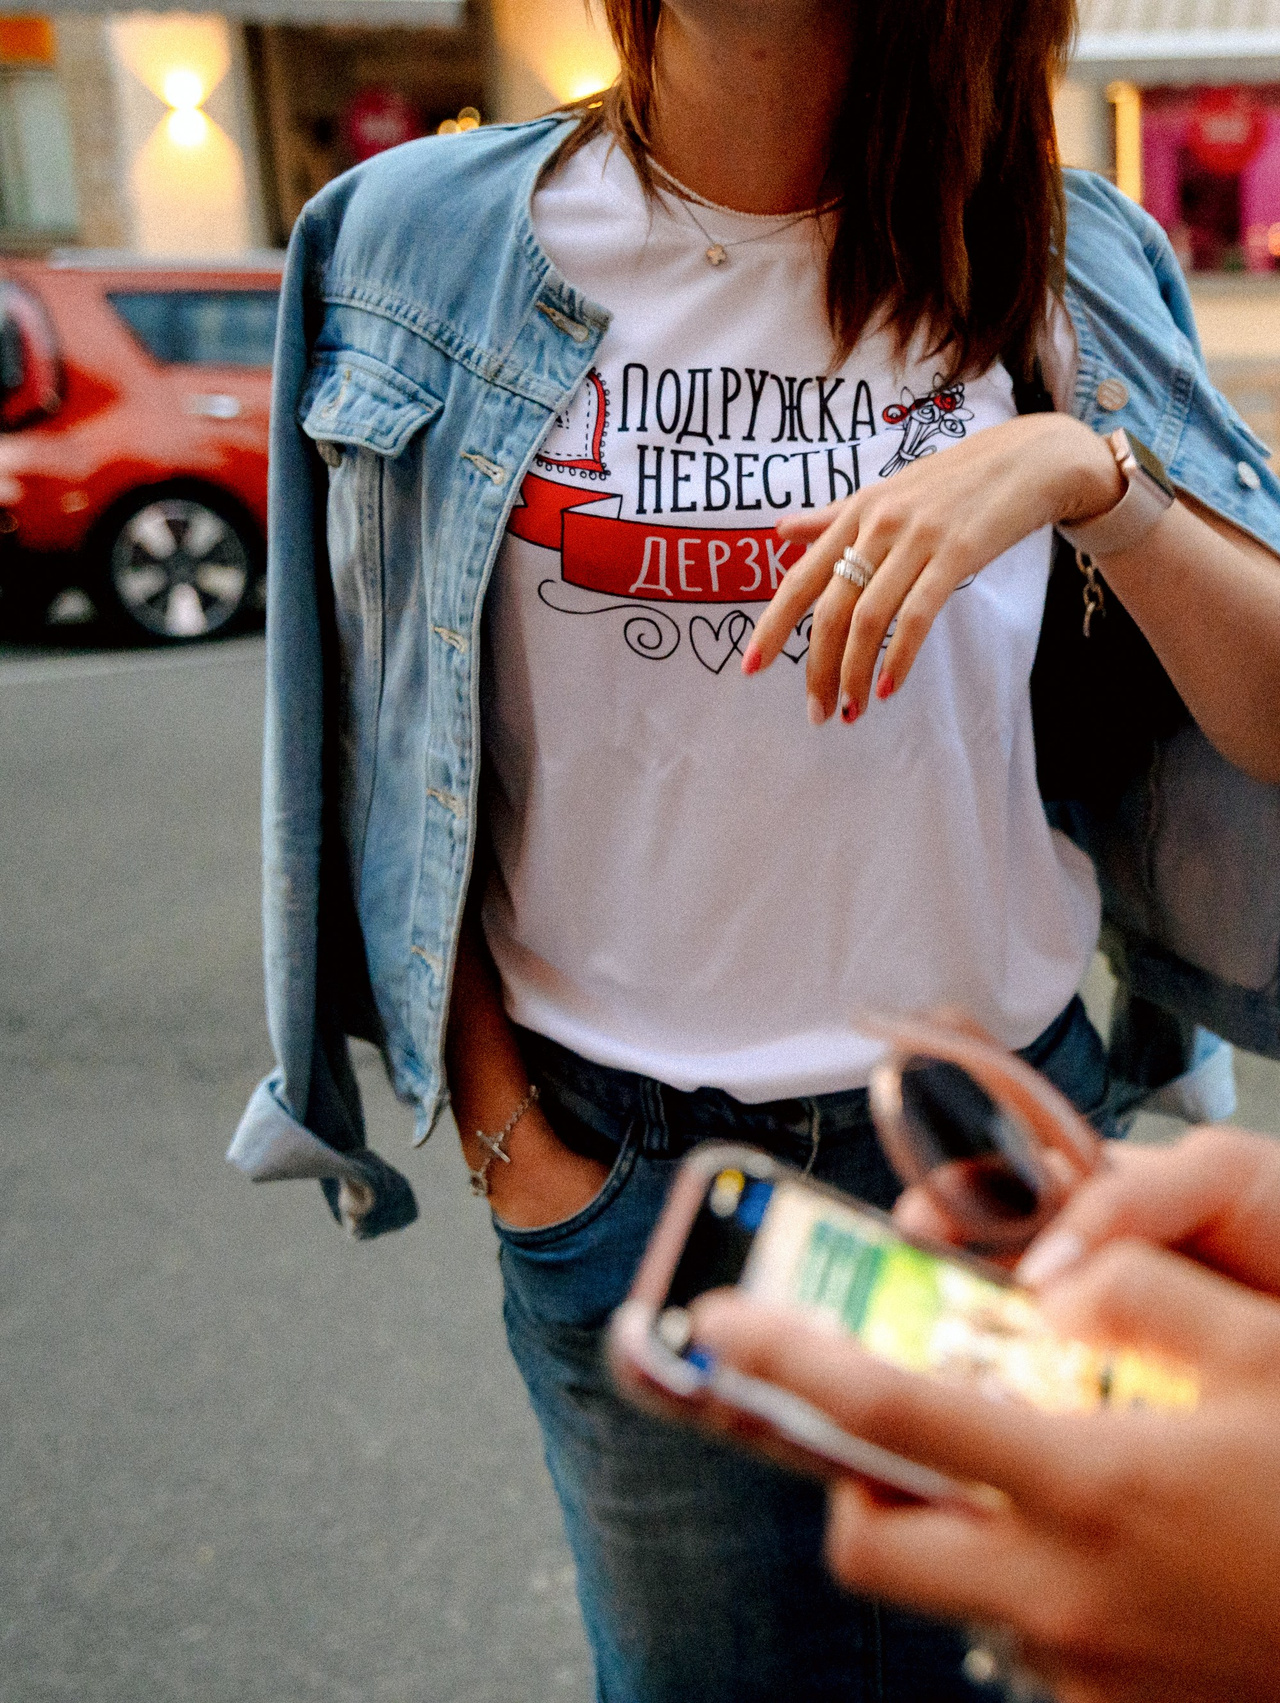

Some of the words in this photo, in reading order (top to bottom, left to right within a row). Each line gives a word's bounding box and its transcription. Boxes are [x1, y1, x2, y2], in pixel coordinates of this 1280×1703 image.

[617, 362, 877, 446] ПОДРУЖКА
[635, 444, 862, 514] НЕВЕСТЫ
[628, 536, 810, 597] ДЕРЗК
